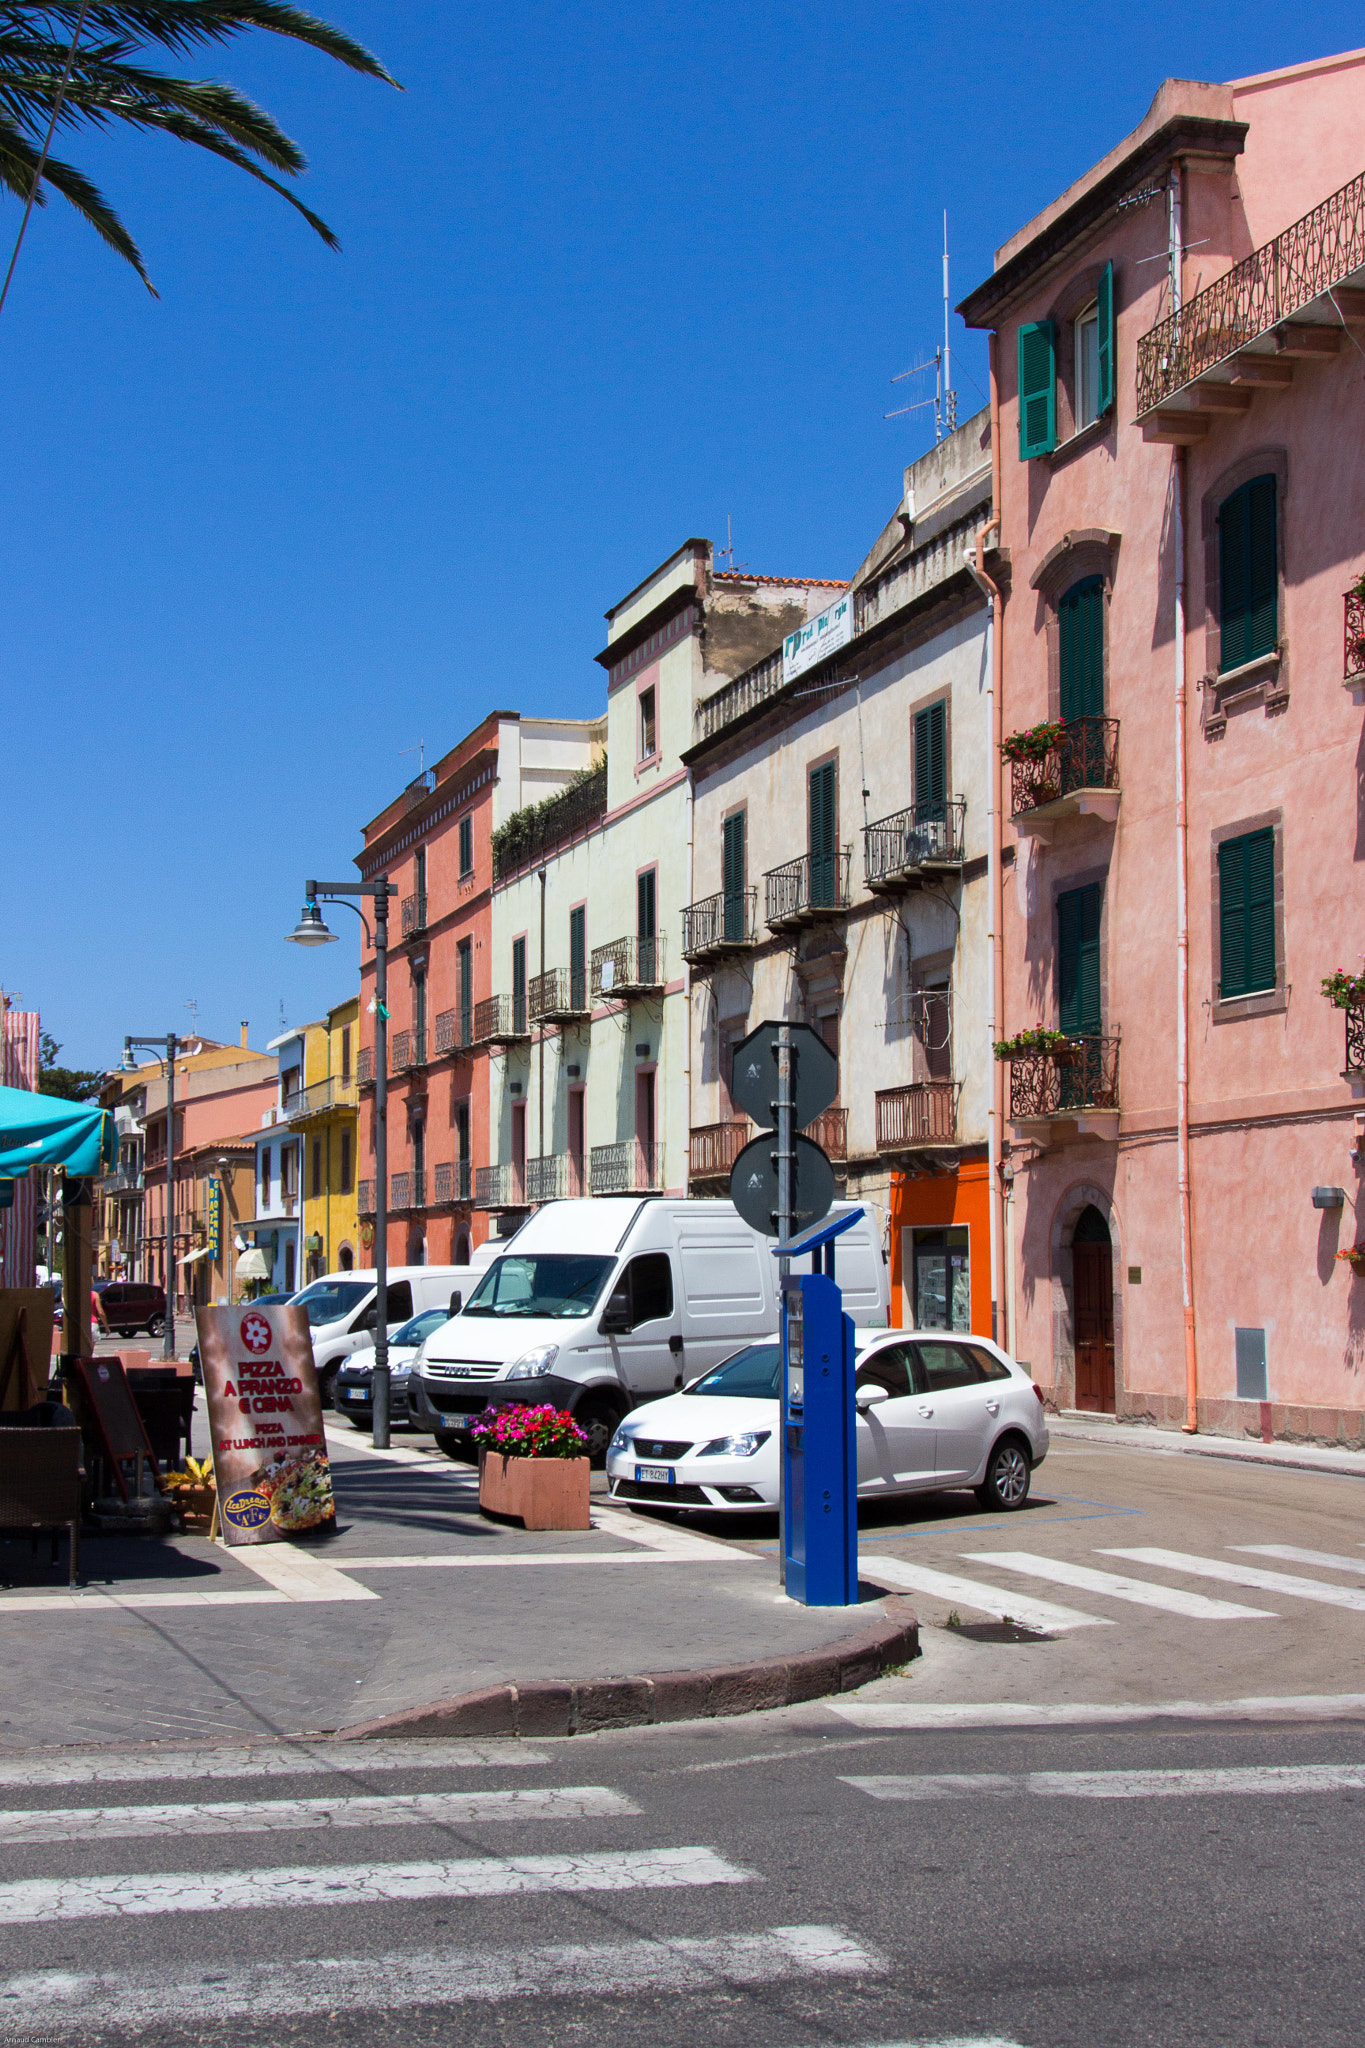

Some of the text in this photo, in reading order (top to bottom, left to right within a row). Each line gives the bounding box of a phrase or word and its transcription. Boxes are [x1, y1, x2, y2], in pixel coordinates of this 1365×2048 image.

[238, 1361, 285, 1378] PIZZA
[224, 1377, 302, 1397] A PRANZO
[239, 1396, 294, 1414] E CENA
[255, 1423, 284, 1434] PIZZA
[219, 1434, 321, 1451] AT LUNCH AND DINNER
